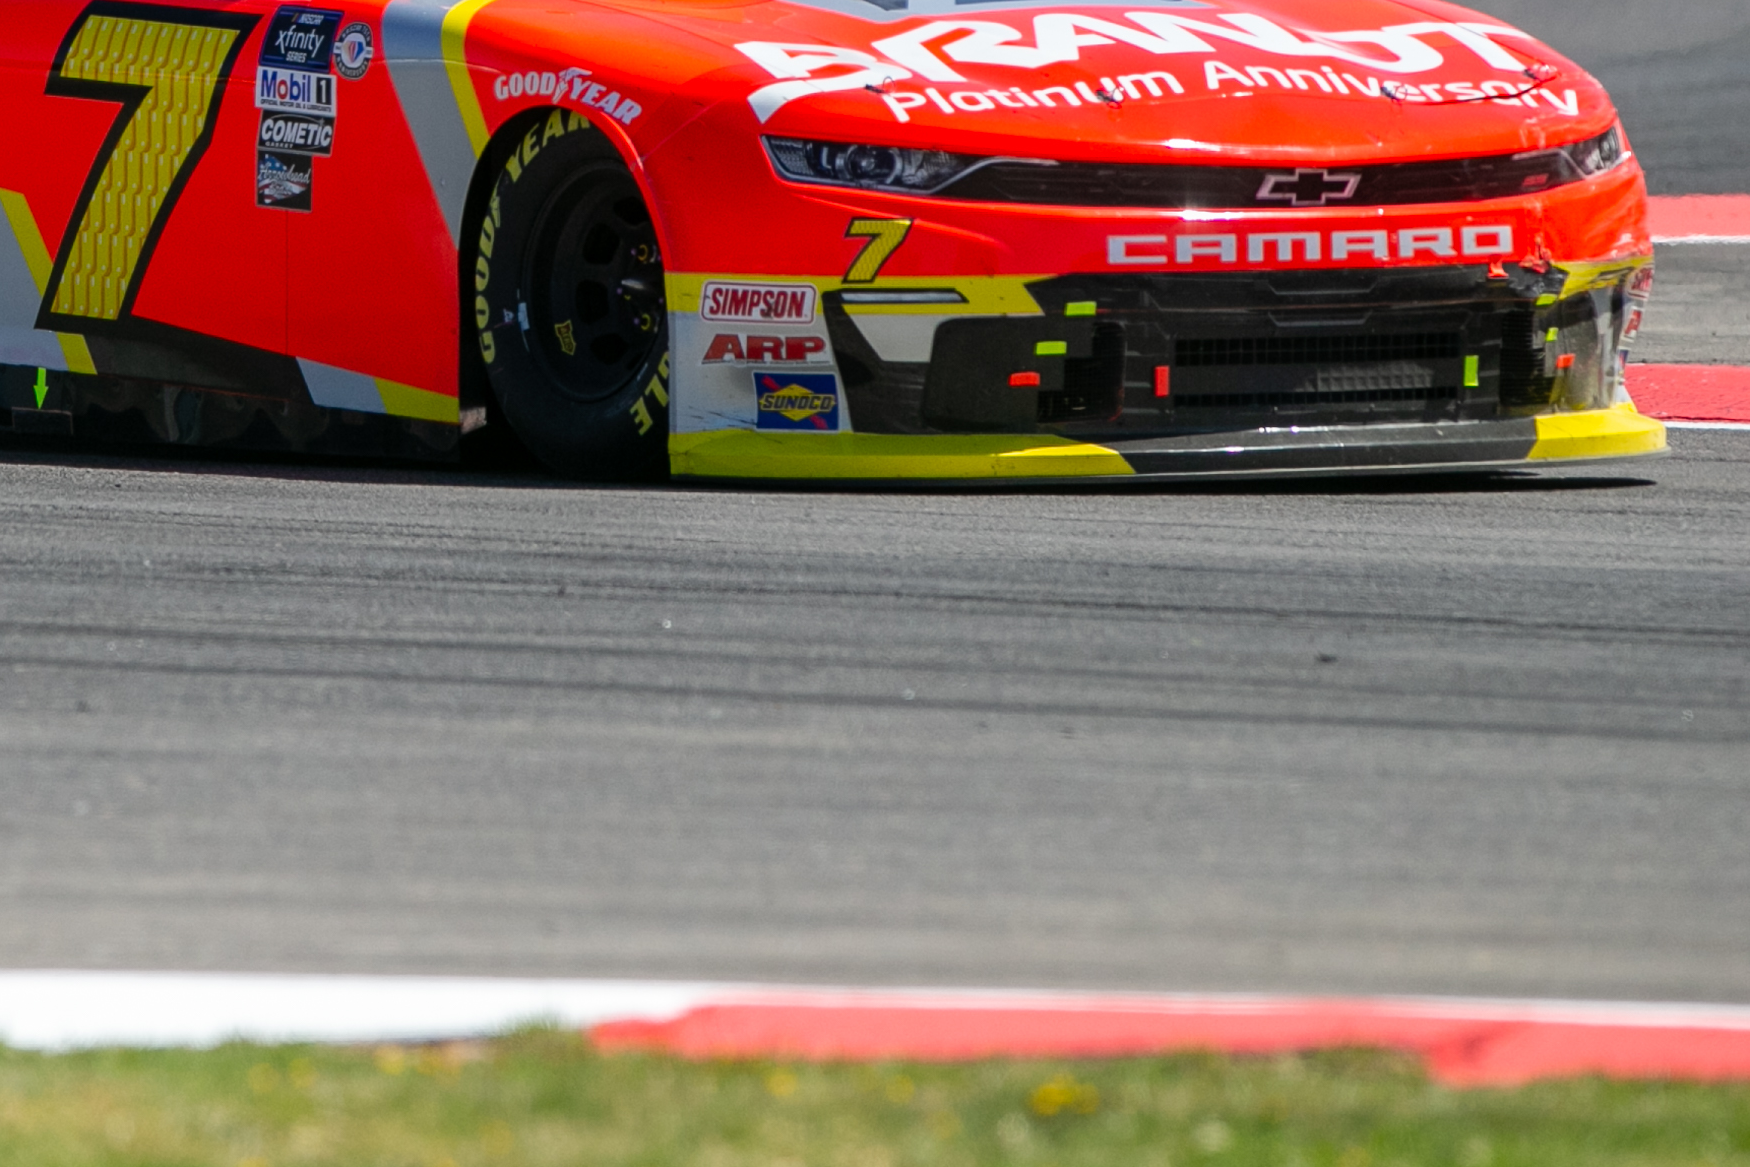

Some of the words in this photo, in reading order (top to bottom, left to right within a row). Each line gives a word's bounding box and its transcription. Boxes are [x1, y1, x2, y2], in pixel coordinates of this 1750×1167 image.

[275, 25, 325, 58] xfinity
[734, 10, 1540, 124] BRANDT
[260, 69, 311, 103] Mobil
[883, 71, 1184, 123] Platinum
[1204, 61, 1579, 116] Anniversary
[261, 119, 333, 148] COMETIC
[35, 0, 263, 330] 7
[841, 217, 914, 284] 7
[1107, 225, 1513, 265] CAMARO
[708, 287, 807, 319] SIMPSON
[702, 334, 826, 361] ARP
[761, 394, 834, 412] SUNOCO
